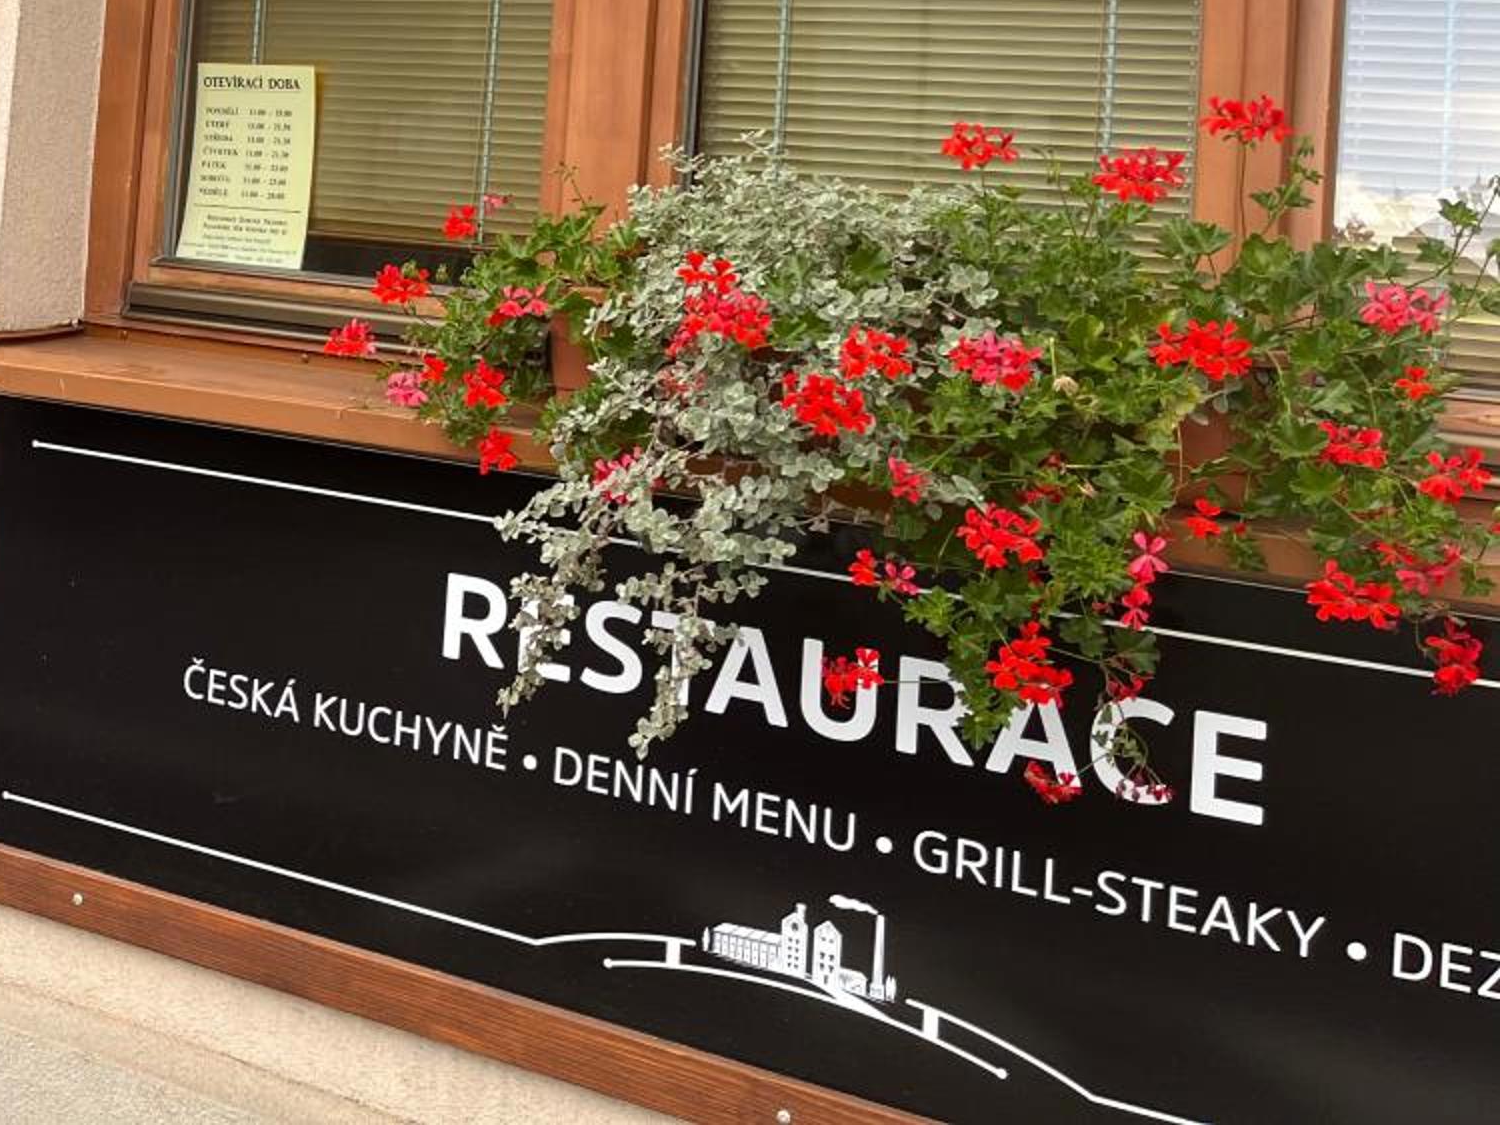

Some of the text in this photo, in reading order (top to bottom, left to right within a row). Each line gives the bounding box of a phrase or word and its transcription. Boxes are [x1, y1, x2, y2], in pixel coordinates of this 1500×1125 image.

[203, 75, 301, 89] OTEVÍRACÍ DOBA
[183, 658, 1500, 1000] ČESKÁ KUCHYNĚ DENNÍ MENU GRILL-STEAKY DEZ
